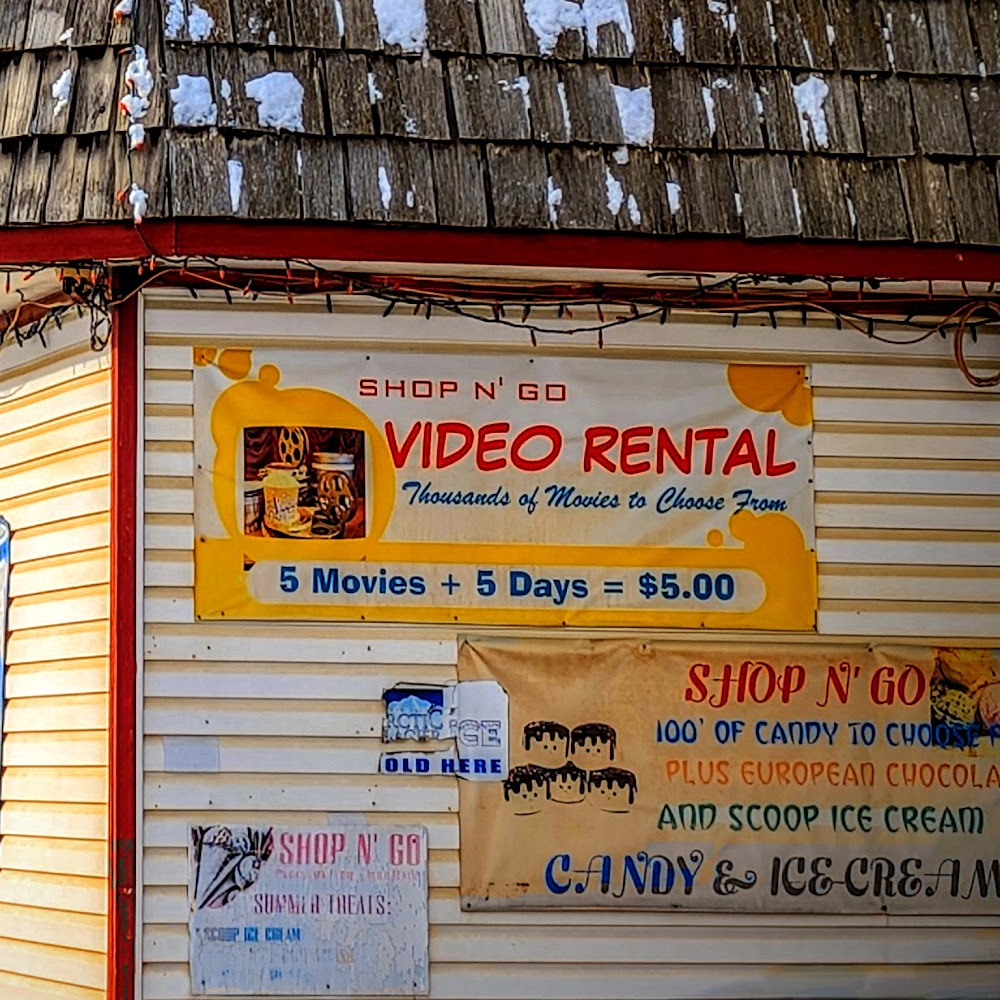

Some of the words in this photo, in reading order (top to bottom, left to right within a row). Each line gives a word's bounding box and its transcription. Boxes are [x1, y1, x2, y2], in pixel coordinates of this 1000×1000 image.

[359, 379, 459, 399] SHOP
[518, 383, 567, 402] GO
[384, 421, 563, 473] VIDEO
[582, 427, 797, 477] RENTAL
[402, 481, 513, 507] Thousands
[517, 487, 539, 517] of
[544, 485, 622, 509] Movies
[627, 490, 649, 509] to
[655, 484, 726, 513] Choose
[734, 492, 788, 514] From
[279, 566, 299, 593] 5
[312, 567, 427, 595] Movies
[440, 573, 461, 596] +
[476, 570, 497, 597] 5
[509, 571, 589, 605] Days
[638, 572, 735, 601] $5.00
[685, 661, 806, 708] SHOP
[869, 663, 927, 706] GO
[714, 719, 746, 744] OF
[755, 720, 838, 746] CANDY
[848, 721, 877, 746] TO
[886, 722, 981, 748] CHOOSE
[441, 758, 503, 774] HERE
[665, 759, 730, 786] PLUS
[740, 760, 875, 787] EUROPEAN
[657, 802, 718, 832] AND
[728, 803, 820, 833] SCOOP
[831, 805, 874, 834] ICE
[884, 805, 985, 835] CREAM
[279, 832, 347, 865] SHOP
[388, 833, 421, 866] GO
[544, 849, 705, 900] CANDY
[713, 858, 758, 896] &
